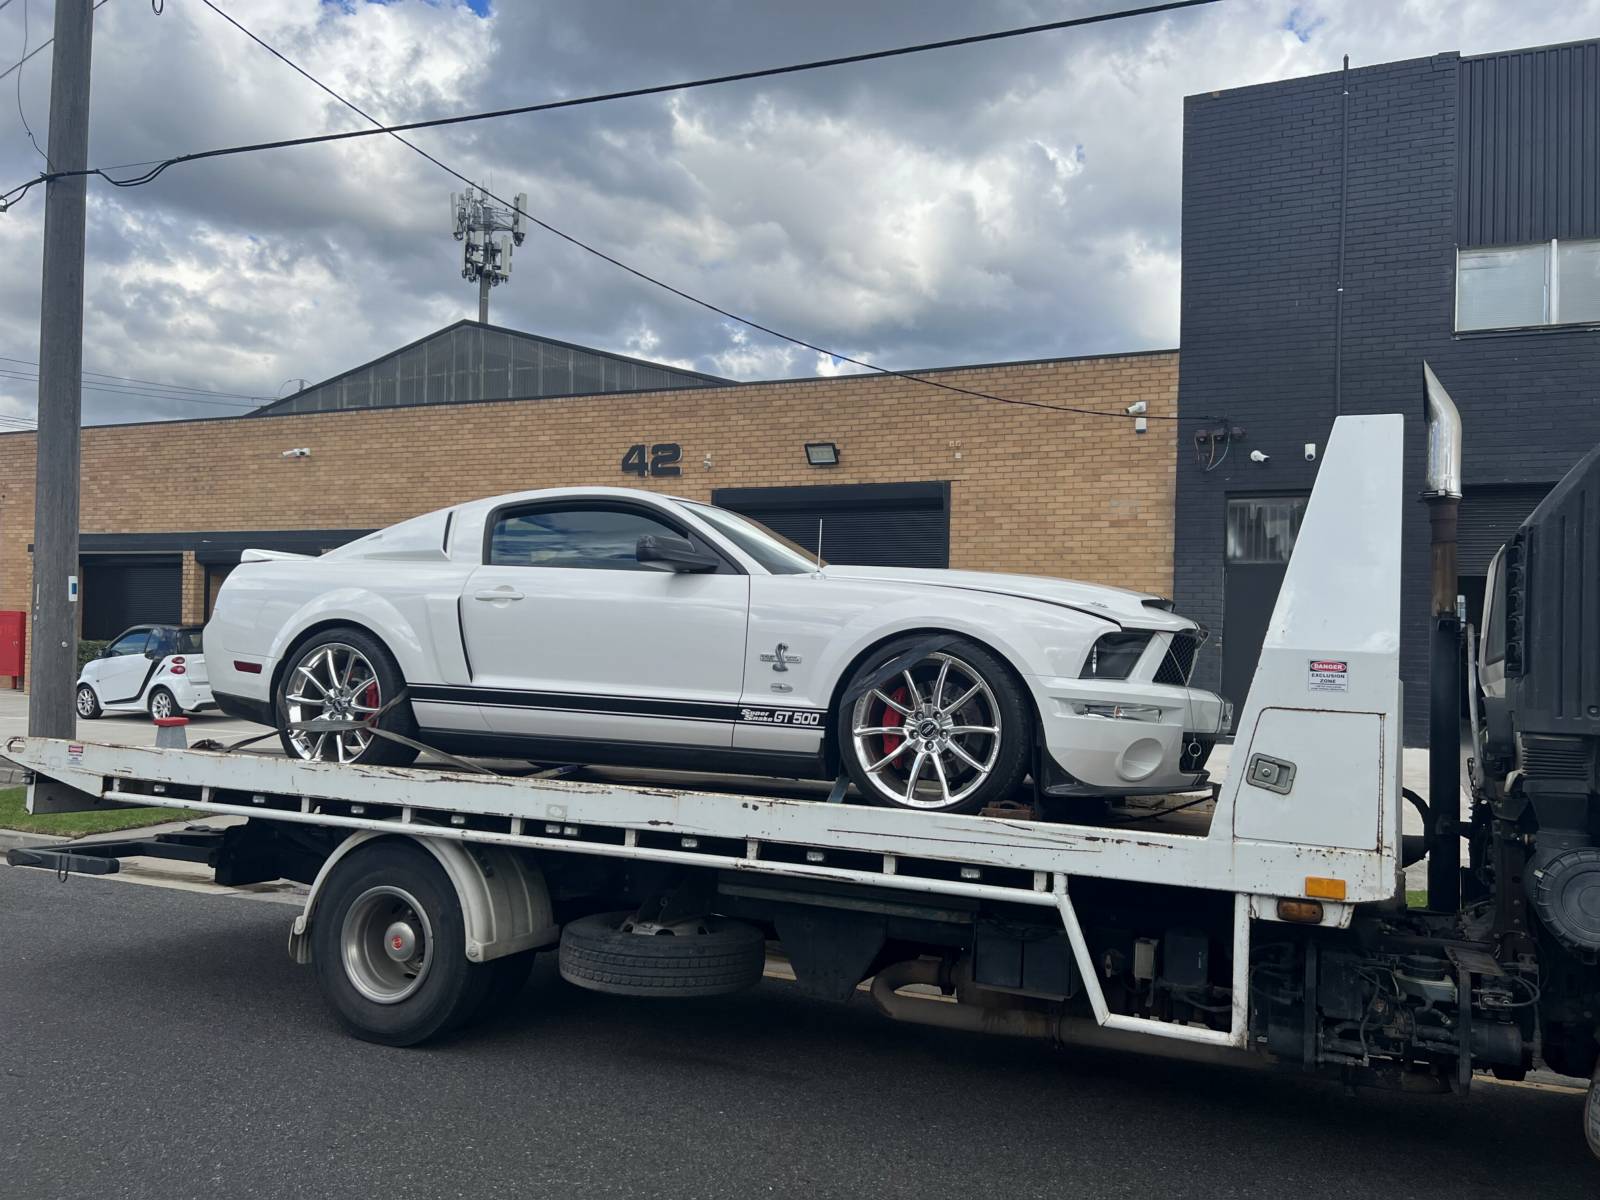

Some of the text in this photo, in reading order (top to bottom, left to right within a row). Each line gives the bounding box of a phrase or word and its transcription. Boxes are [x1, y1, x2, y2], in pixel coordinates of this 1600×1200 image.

[622, 443, 682, 477] 42
[774, 710, 820, 725] GT 500
